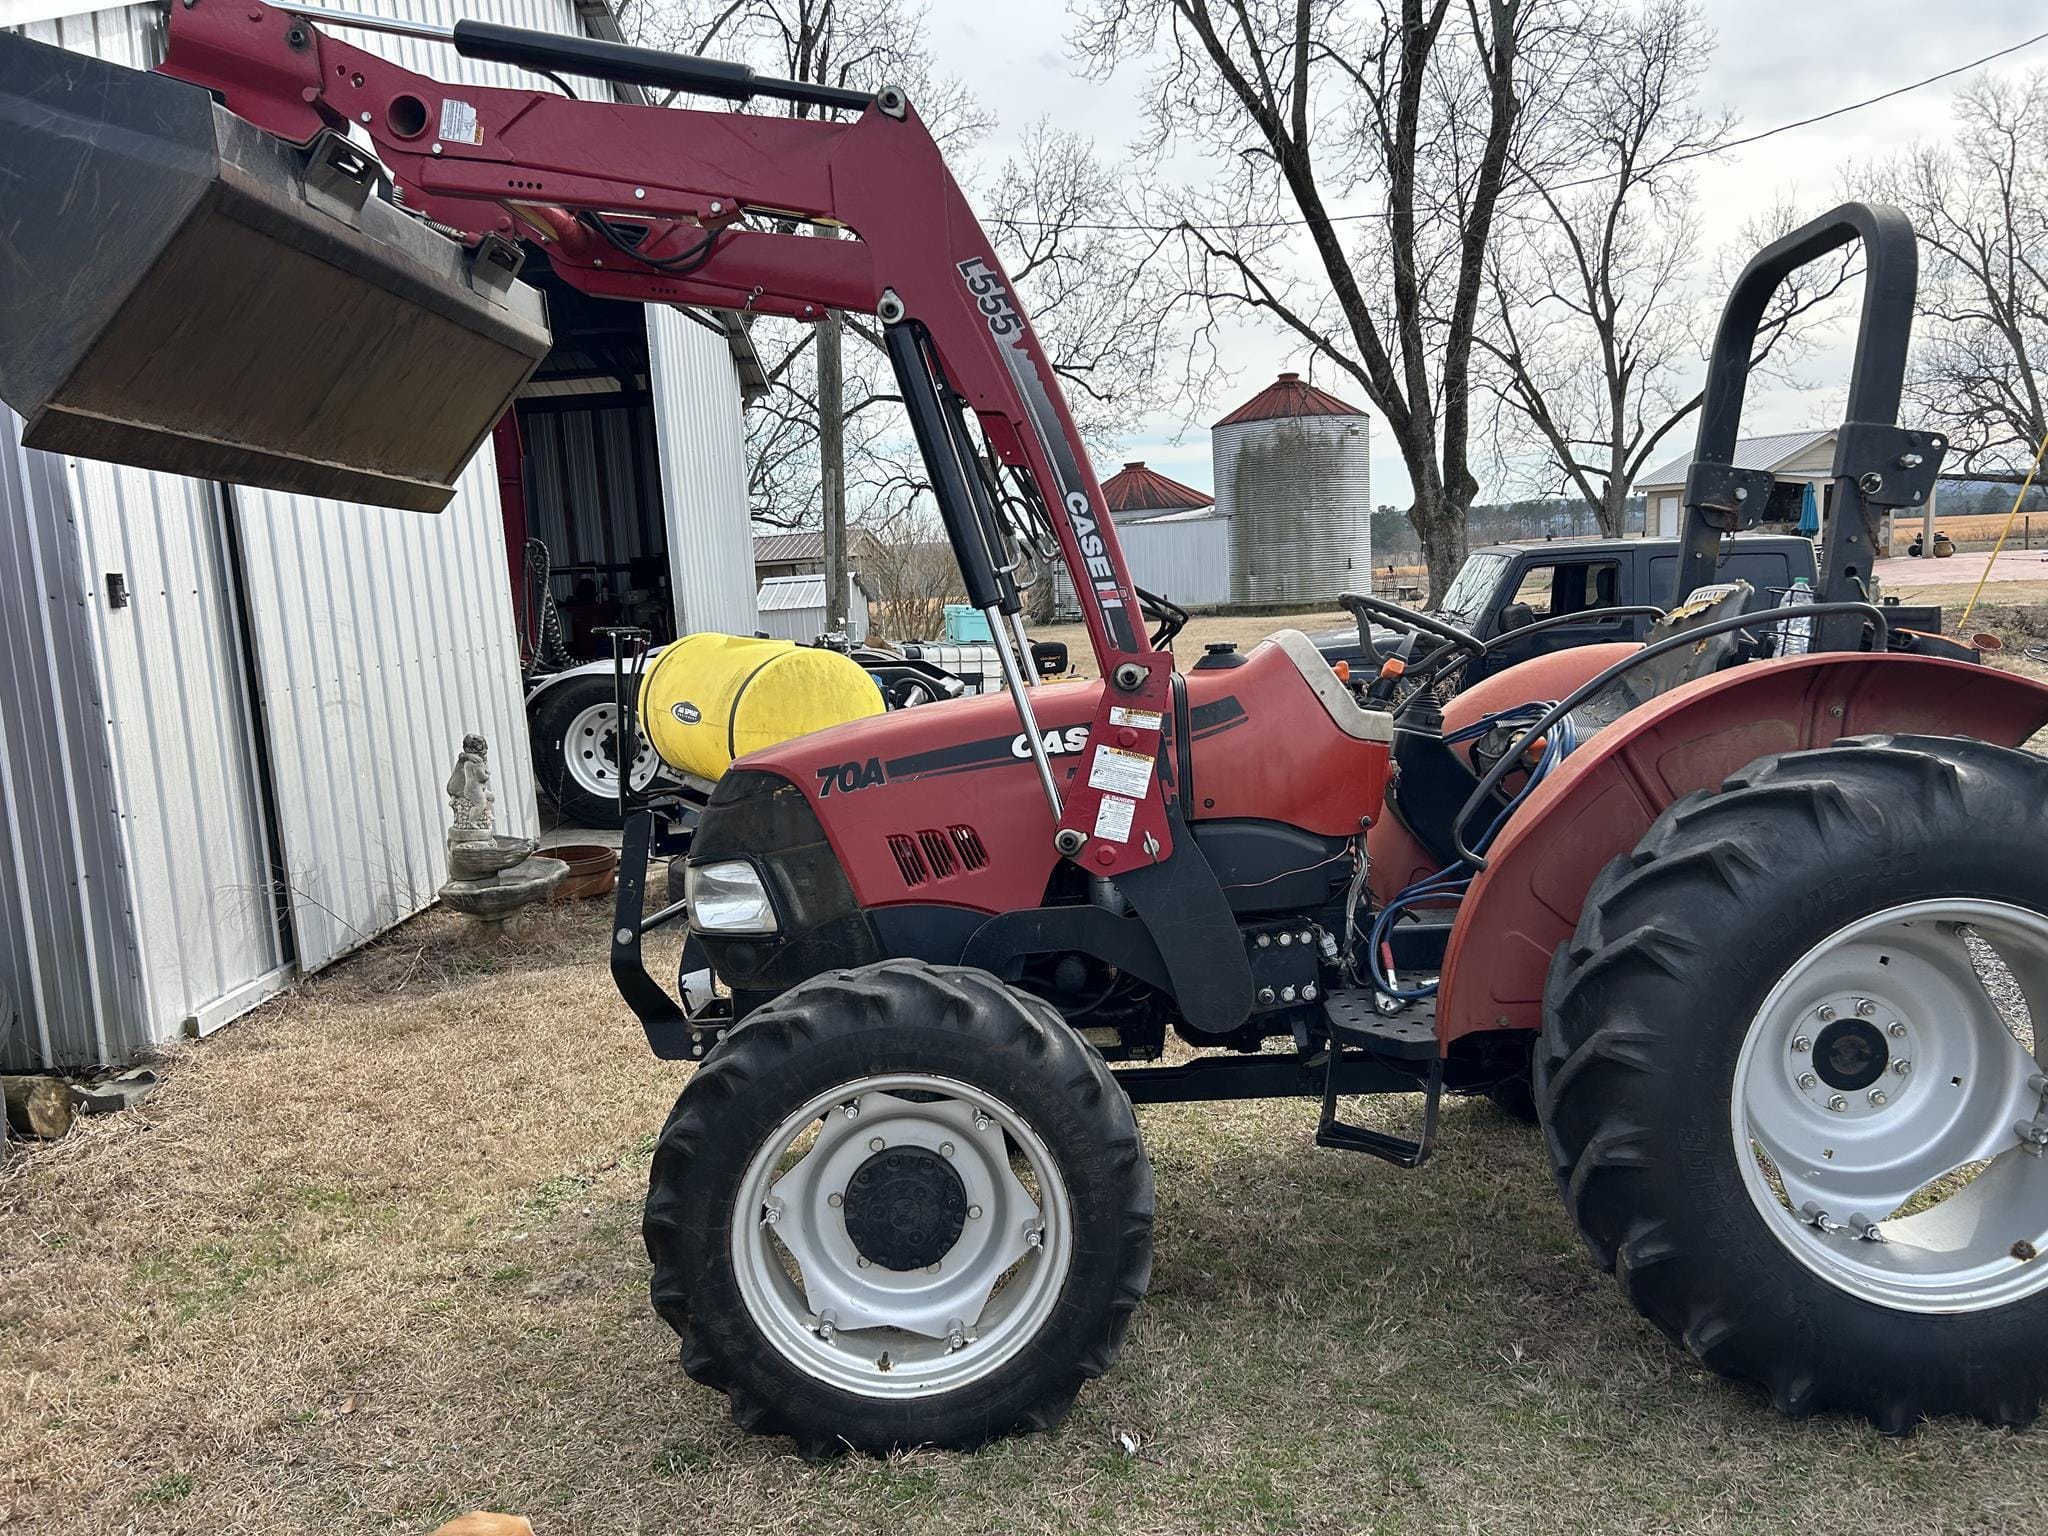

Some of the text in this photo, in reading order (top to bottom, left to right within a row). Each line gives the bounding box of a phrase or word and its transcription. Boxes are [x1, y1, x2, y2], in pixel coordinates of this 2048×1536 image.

[956, 256, 1025, 335] L555
[1066, 491, 1112, 578] CASE
[1133, 709, 1160, 718] WARNING
[1012, 727, 1090, 758] CAS
[1121, 750, 1150, 761] WARNING
[815, 756, 887, 799] 70A
